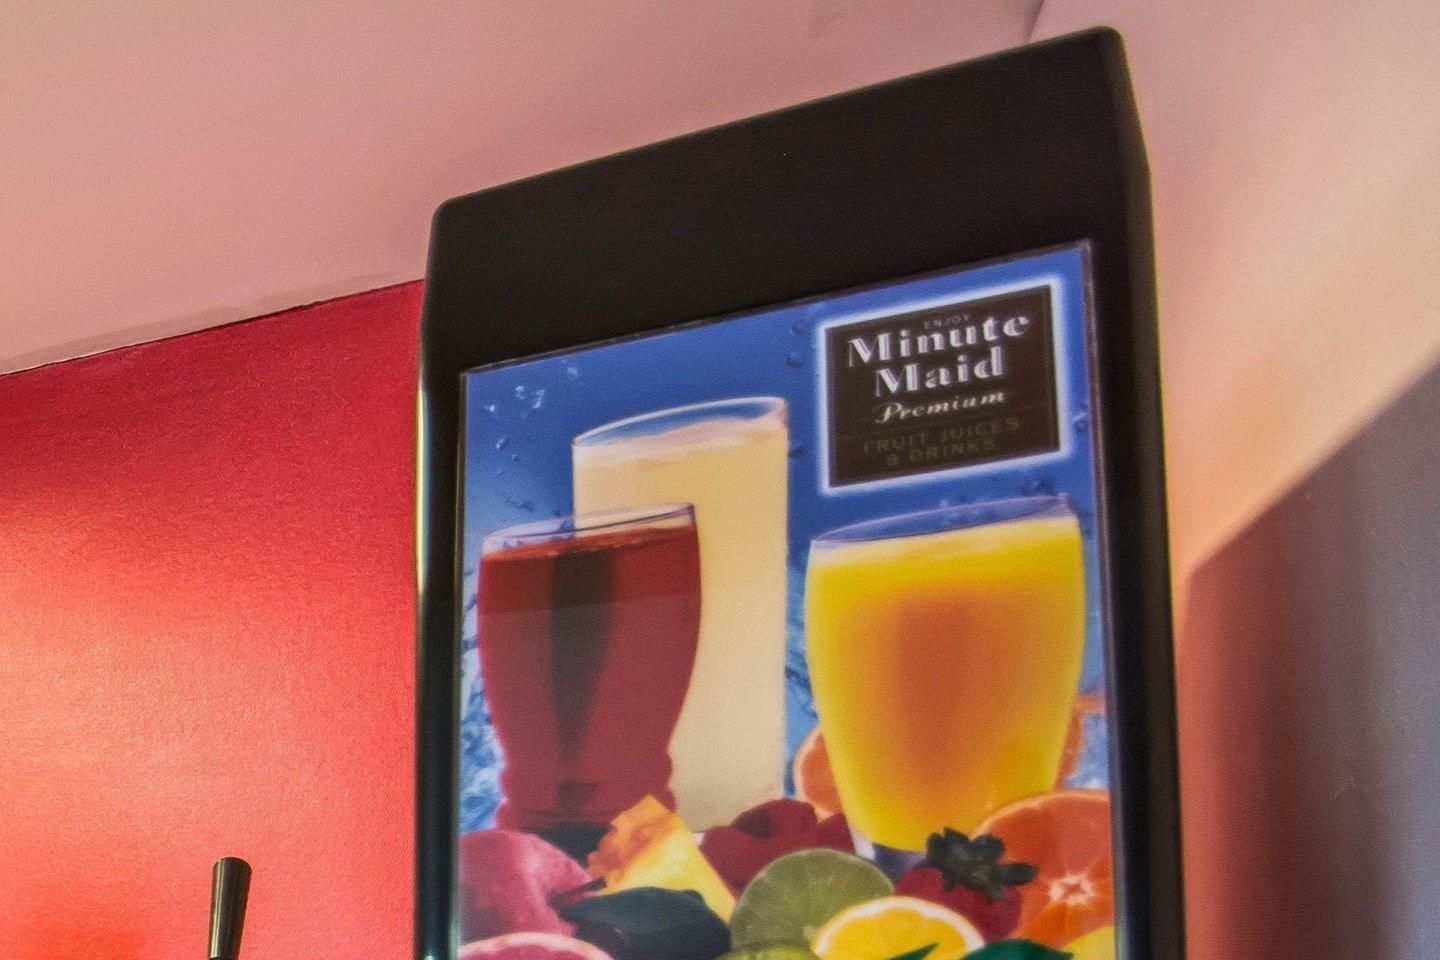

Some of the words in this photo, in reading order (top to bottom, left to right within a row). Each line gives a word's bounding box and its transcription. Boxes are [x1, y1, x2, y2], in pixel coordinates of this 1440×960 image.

[848, 314, 1030, 368] Minute
[923, 313, 970, 330] ENJOY
[875, 345, 1005, 398] Maid
[874, 391, 1005, 424] Premium
[863, 432, 928, 456] FRUIT
[941, 417, 1020, 443] JUICES
